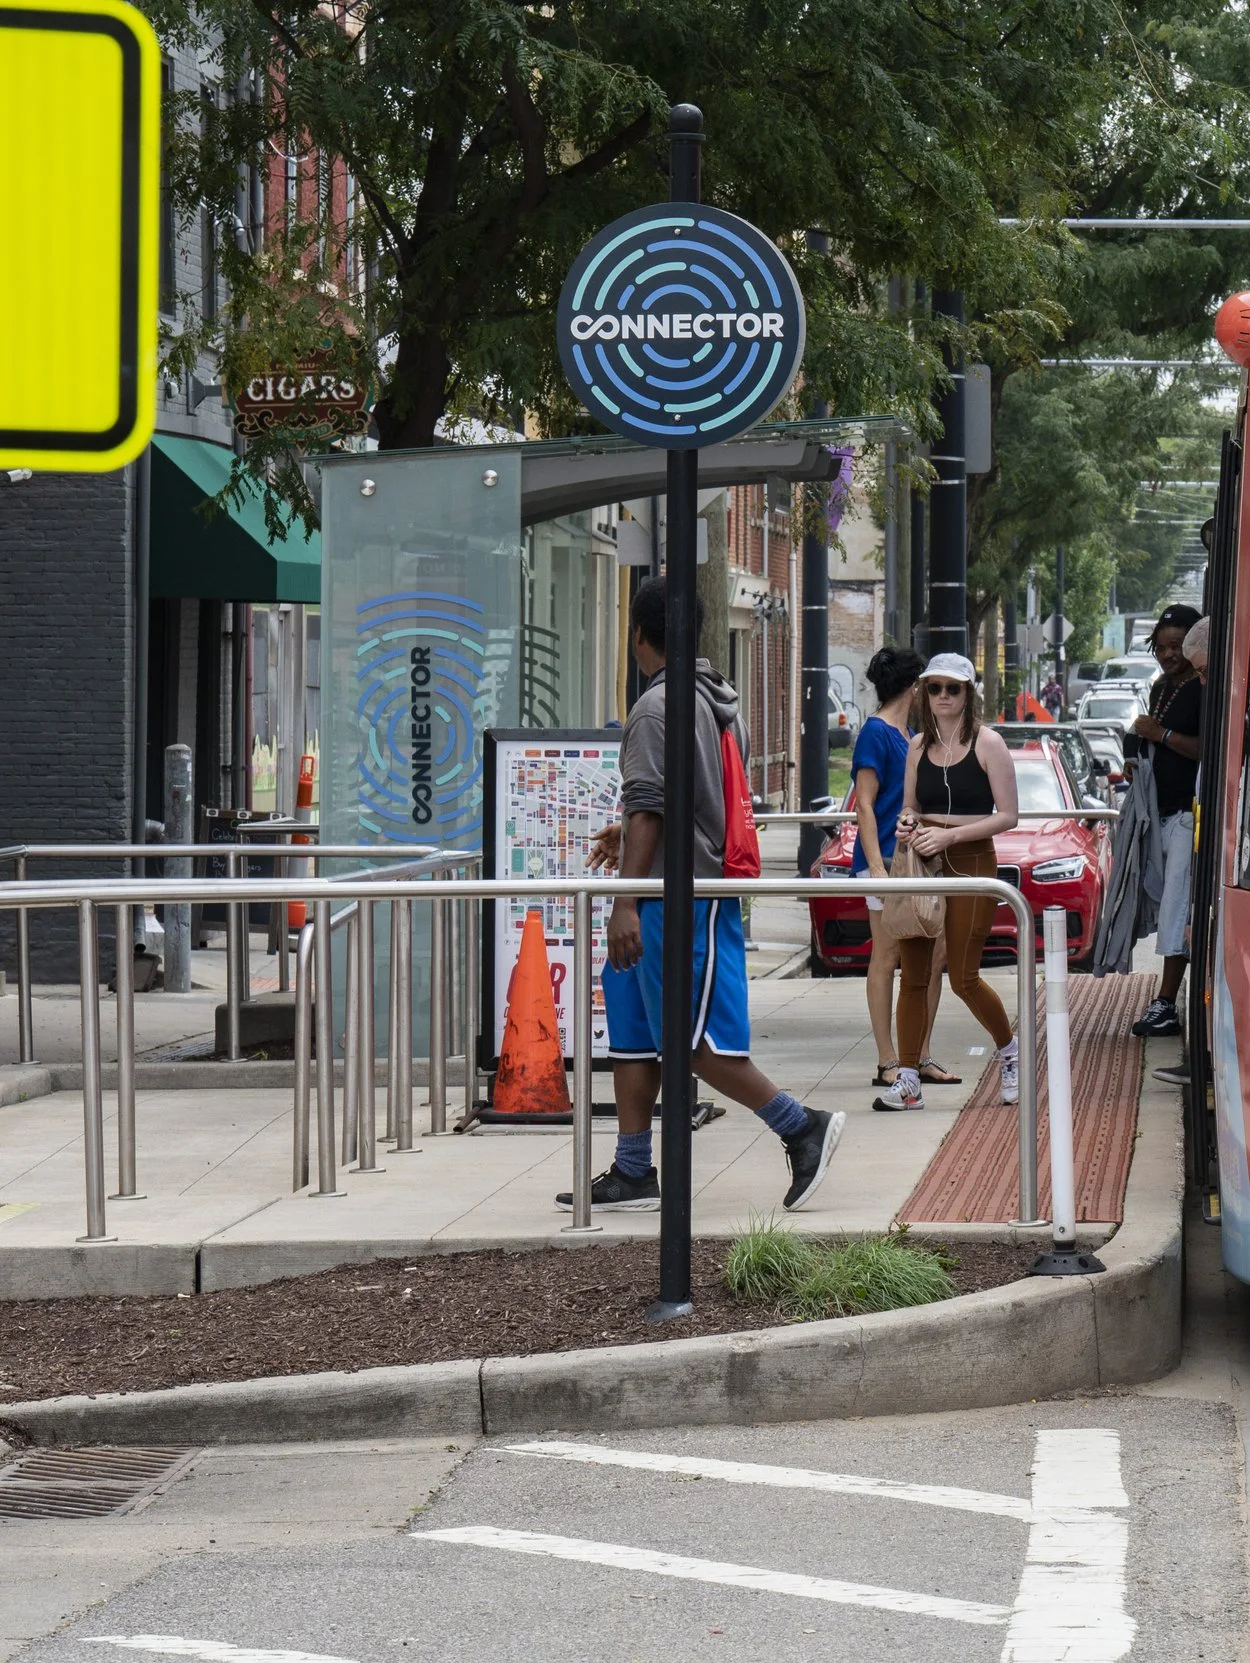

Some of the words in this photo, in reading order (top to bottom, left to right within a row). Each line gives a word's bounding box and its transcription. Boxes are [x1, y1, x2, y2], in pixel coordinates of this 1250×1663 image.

[570, 312, 784, 340] CONNECTOR
[247, 375, 356, 401] CIGARS
[410, 646, 433, 825] CONNECTOR
